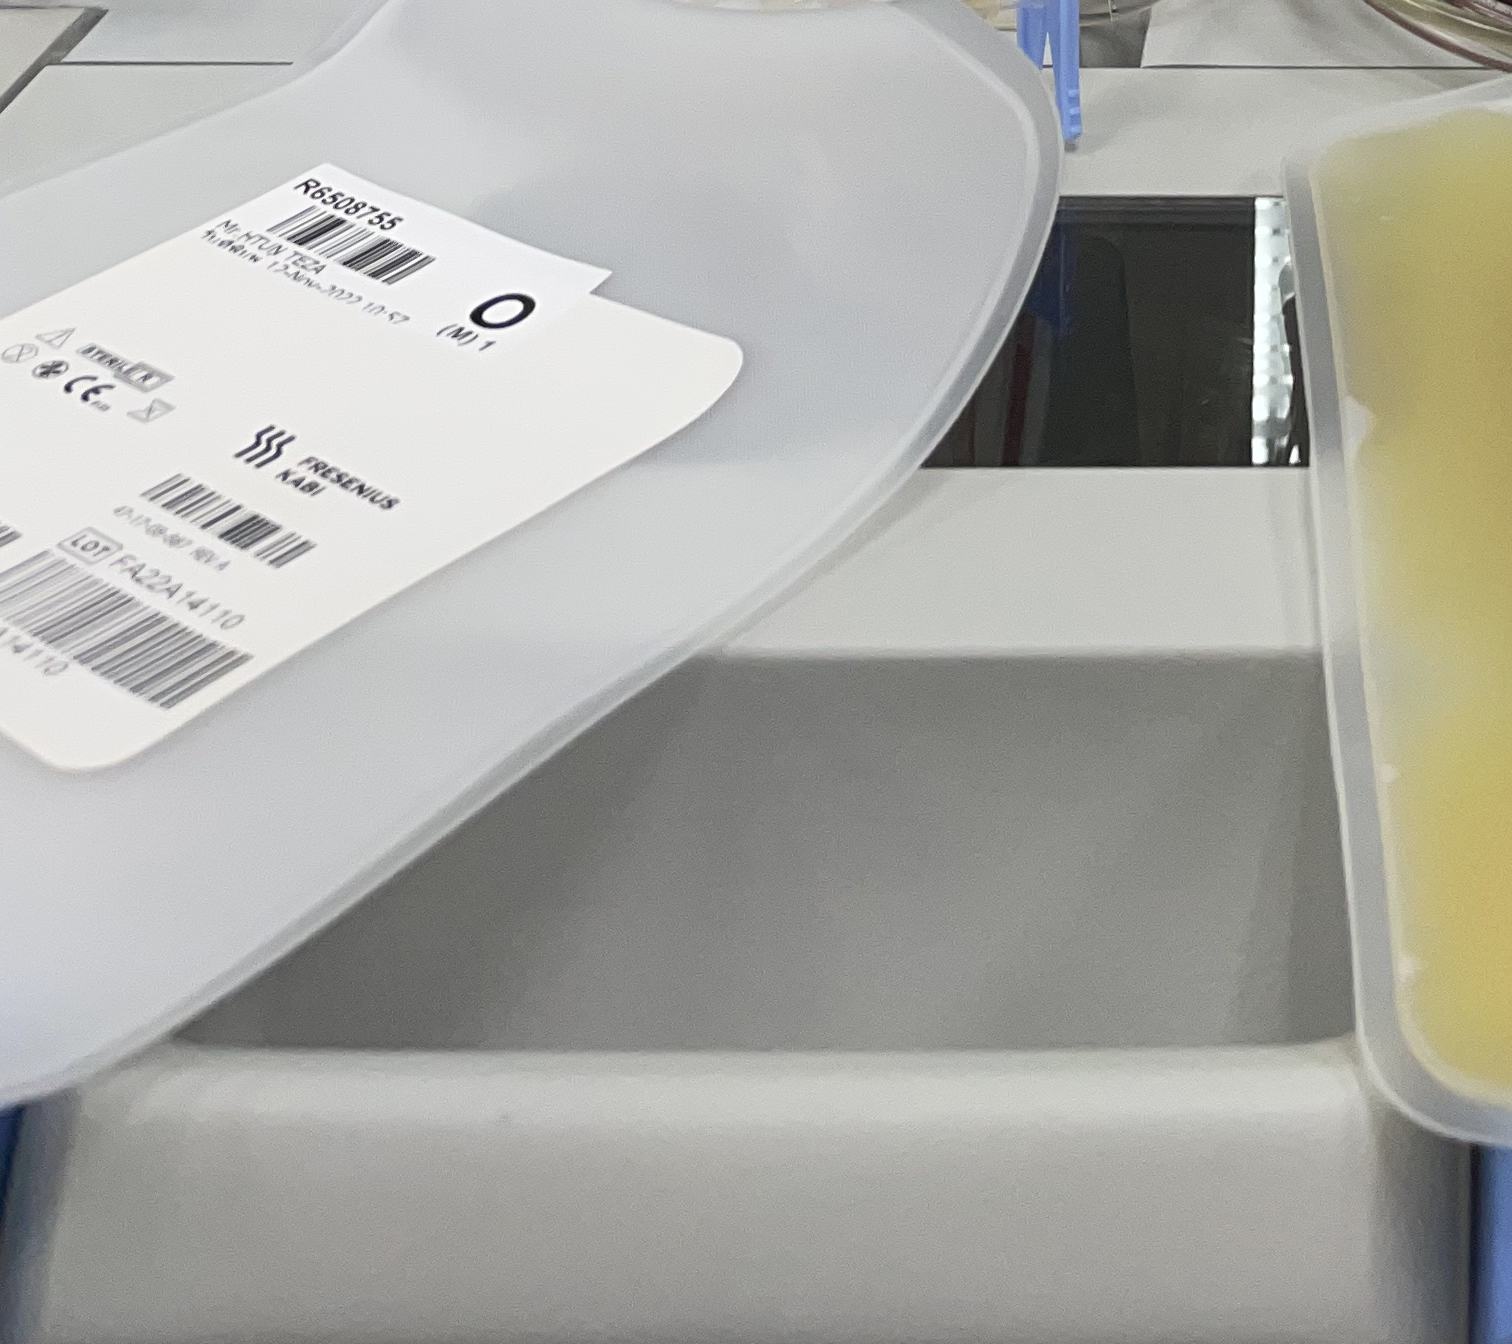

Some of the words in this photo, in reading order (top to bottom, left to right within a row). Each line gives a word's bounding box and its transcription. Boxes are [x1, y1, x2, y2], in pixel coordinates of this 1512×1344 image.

[293, 178, 404, 231] R6508755
[469, 292, 537, 330] O
[275, 468, 326, 497] KABI
[297, 456, 400, 510] FRESENIUS
[108, 554, 246, 631] FA22A14110
